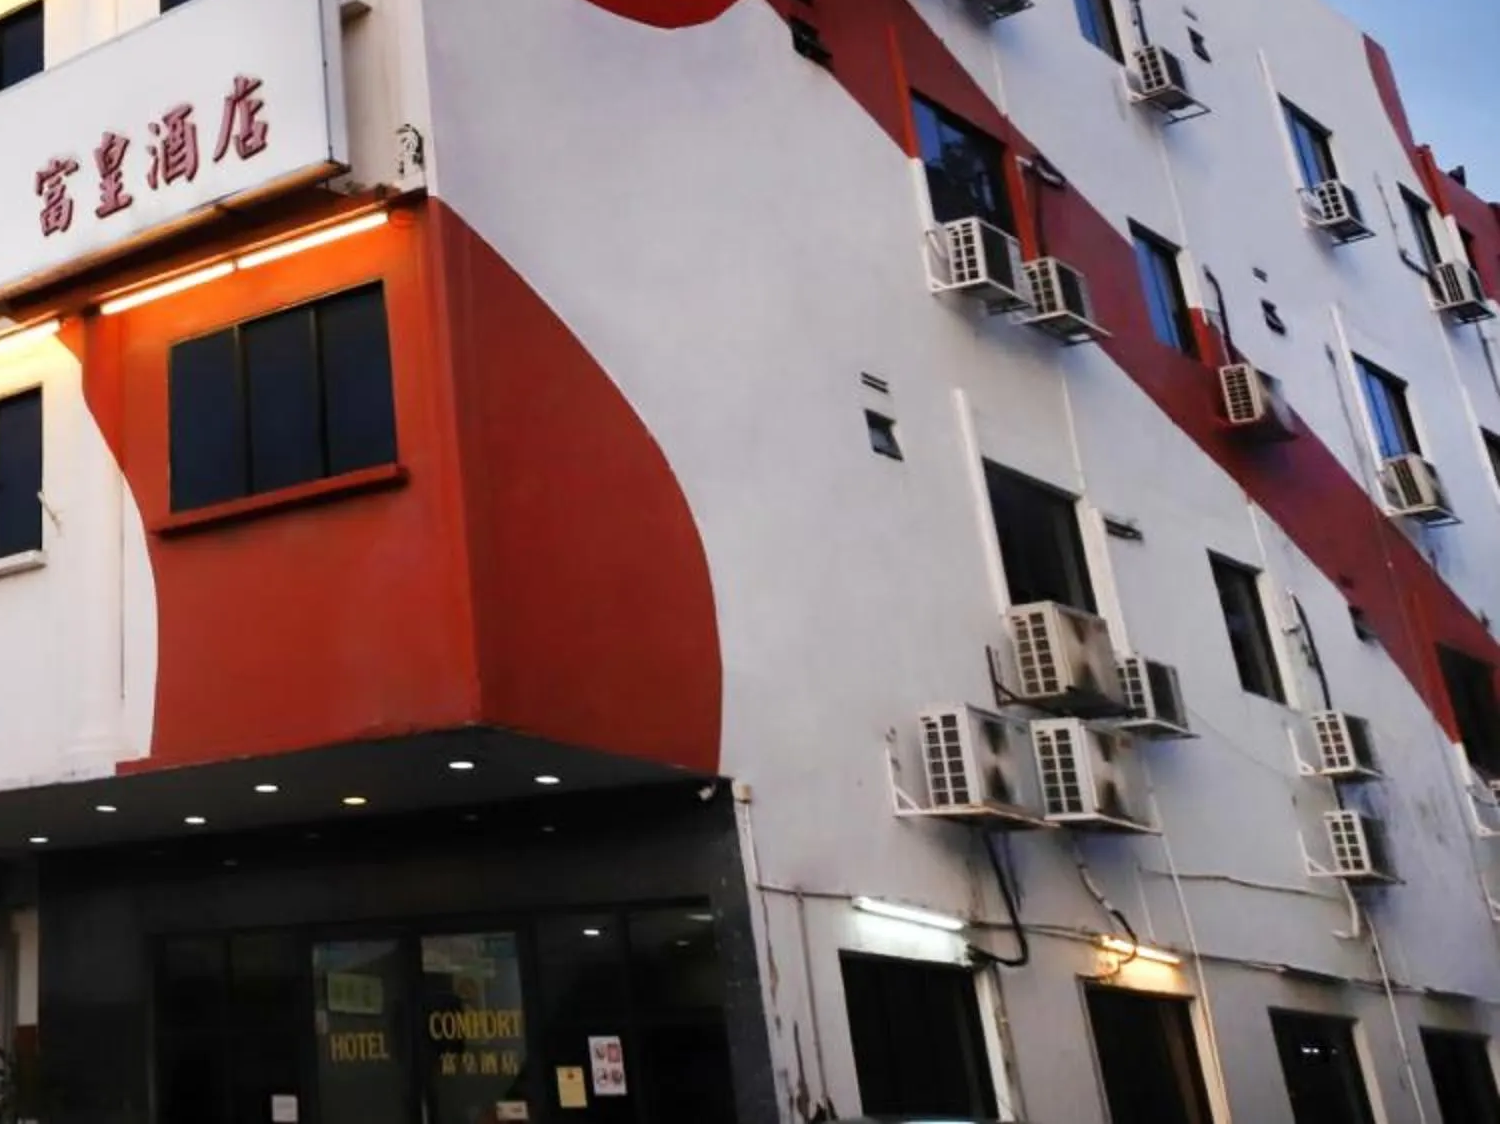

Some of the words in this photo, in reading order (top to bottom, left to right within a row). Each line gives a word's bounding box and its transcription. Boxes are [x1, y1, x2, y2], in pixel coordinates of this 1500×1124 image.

[35, 75, 269, 237] 富皇酒店
[427, 1008, 522, 1041] COMFORT
[329, 1030, 391, 1063] HOTEL
